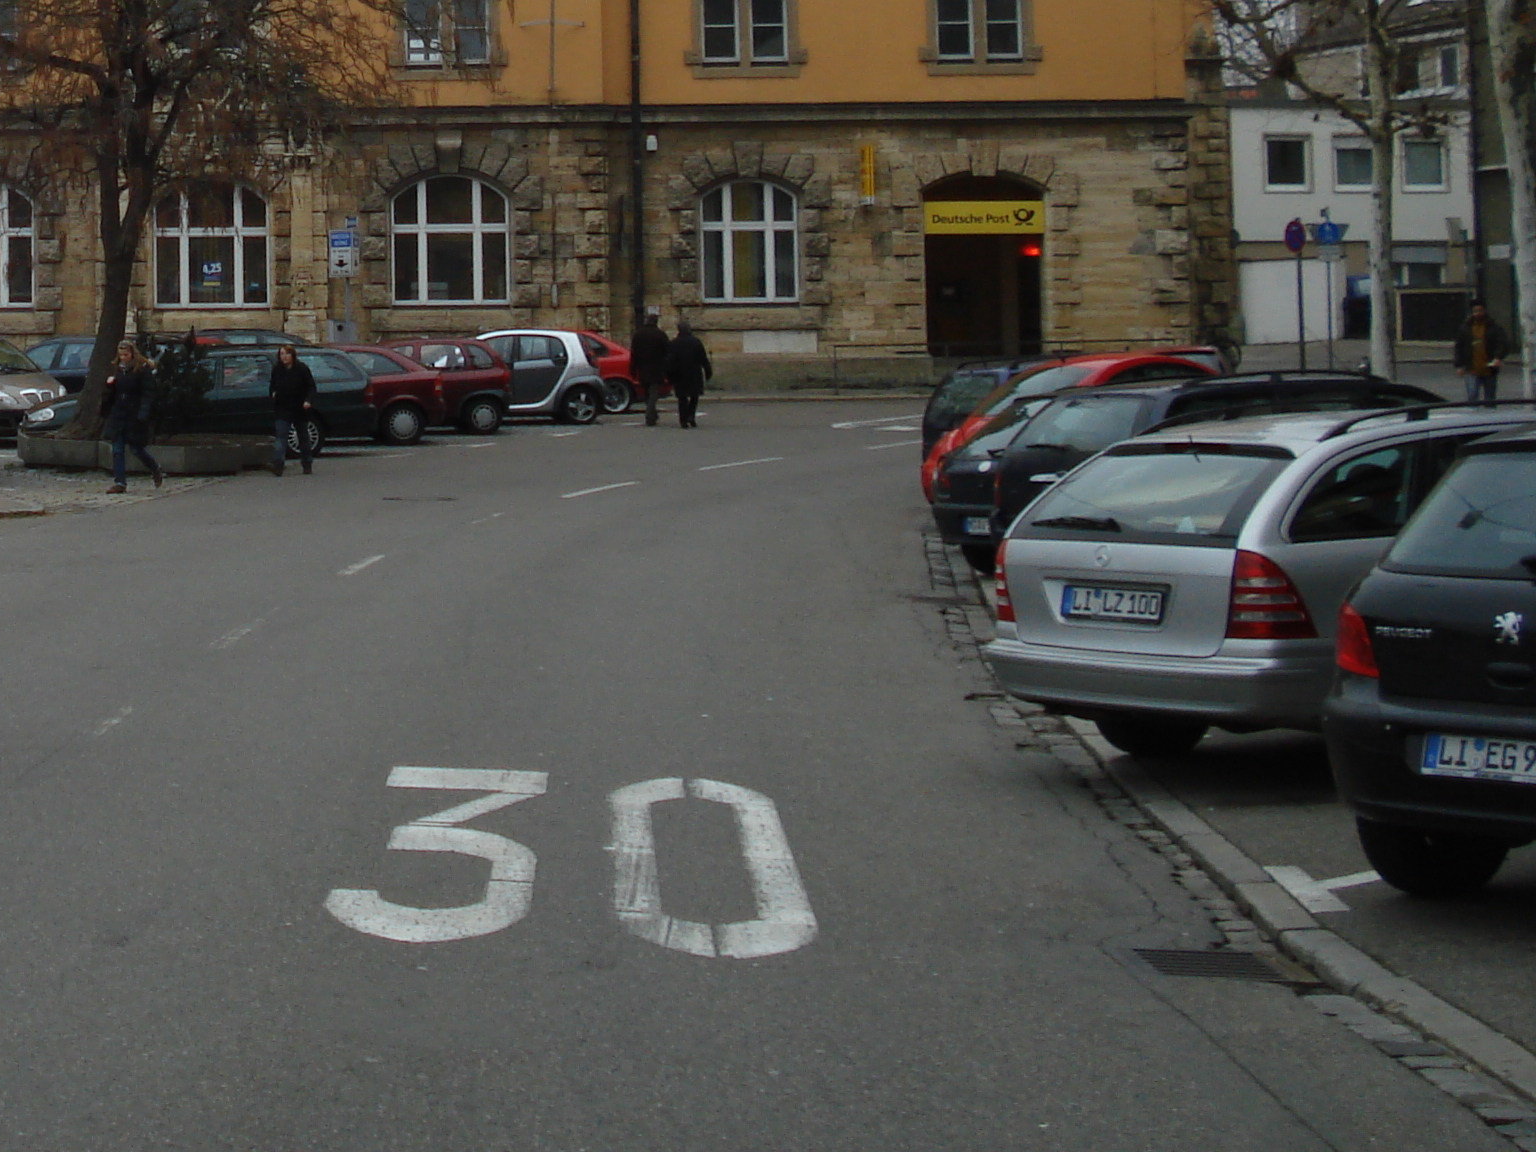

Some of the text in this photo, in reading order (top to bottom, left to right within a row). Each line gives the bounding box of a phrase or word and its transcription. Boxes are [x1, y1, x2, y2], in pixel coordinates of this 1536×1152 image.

[932, 214, 1010, 224] Deutsche Post
[1072, 587, 1160, 616] LI LZ 100
[1439, 737, 1468, 766] LI
[1485, 741, 1518, 771] EG
[325, 765, 819, 959] 30
